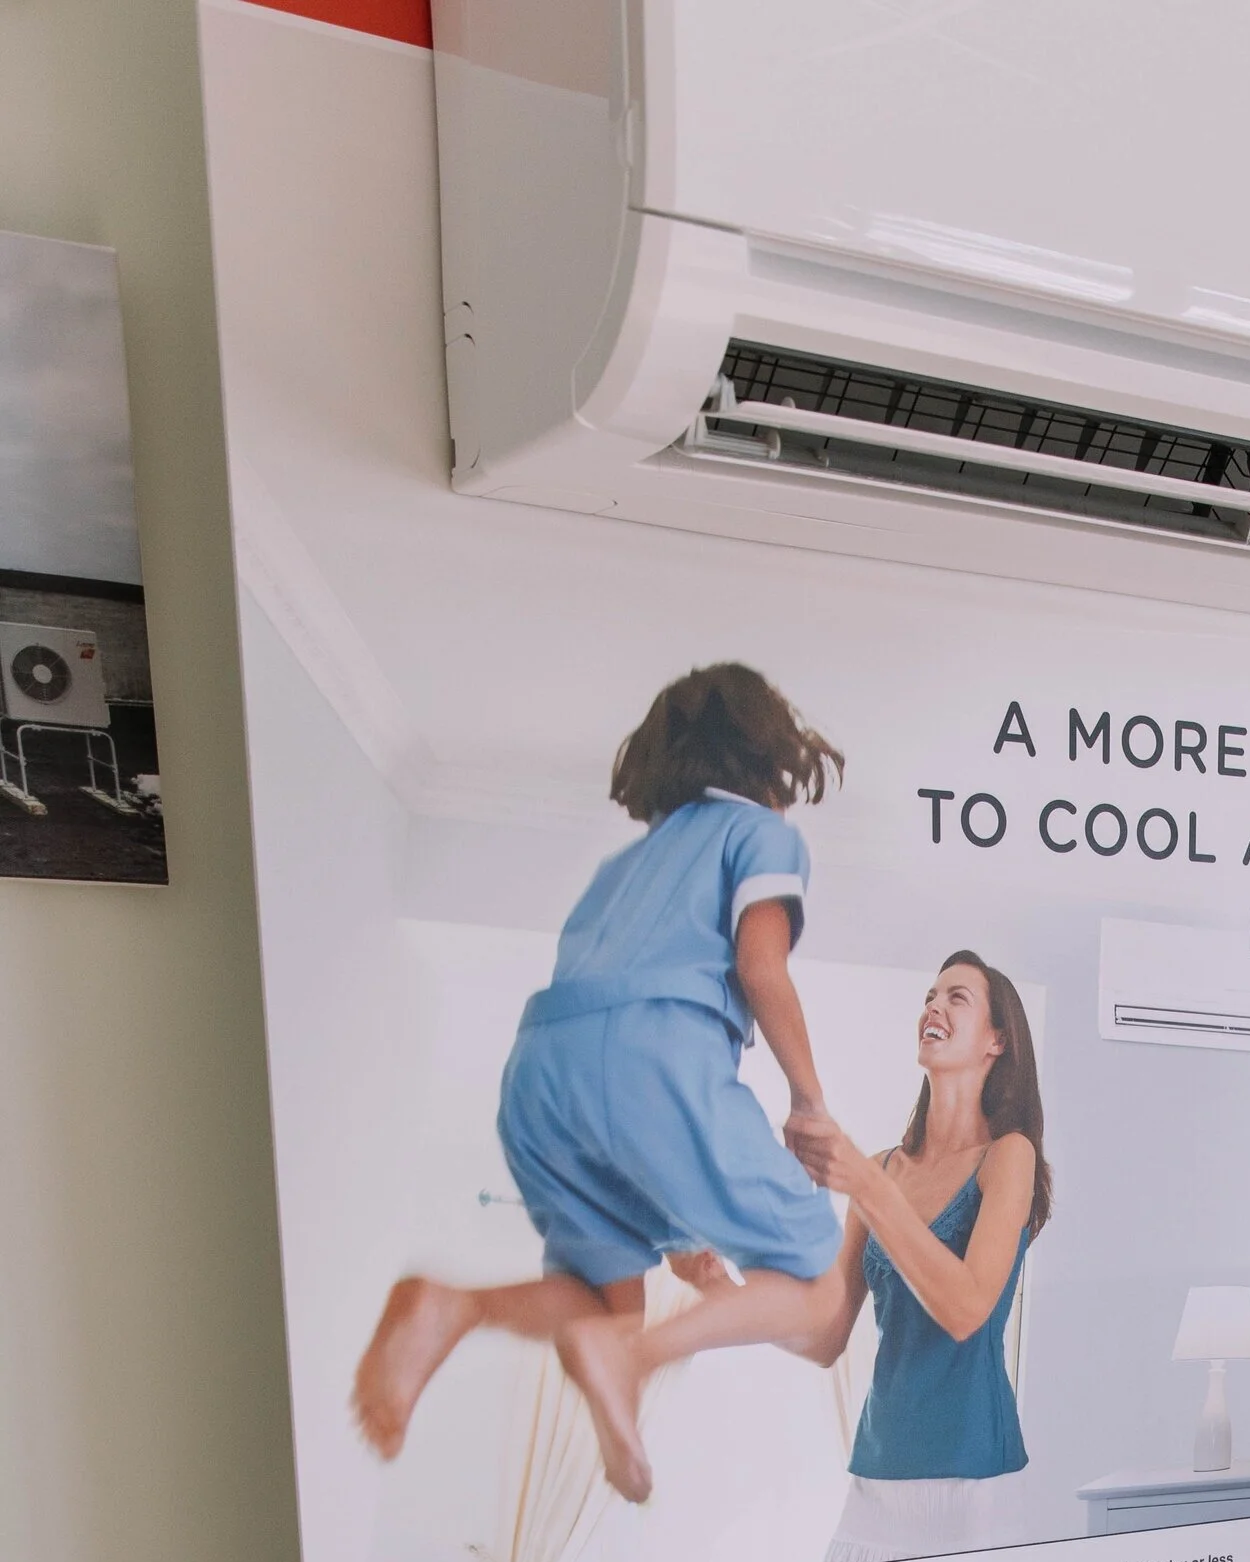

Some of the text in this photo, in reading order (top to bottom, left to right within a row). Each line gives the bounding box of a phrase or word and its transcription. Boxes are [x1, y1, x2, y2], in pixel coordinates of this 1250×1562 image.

[993, 701, 1036, 758] A
[1069, 708, 1248, 778] MORE
[917, 788, 1007, 848] TO
[1039, 800, 1216, 863] COOL
